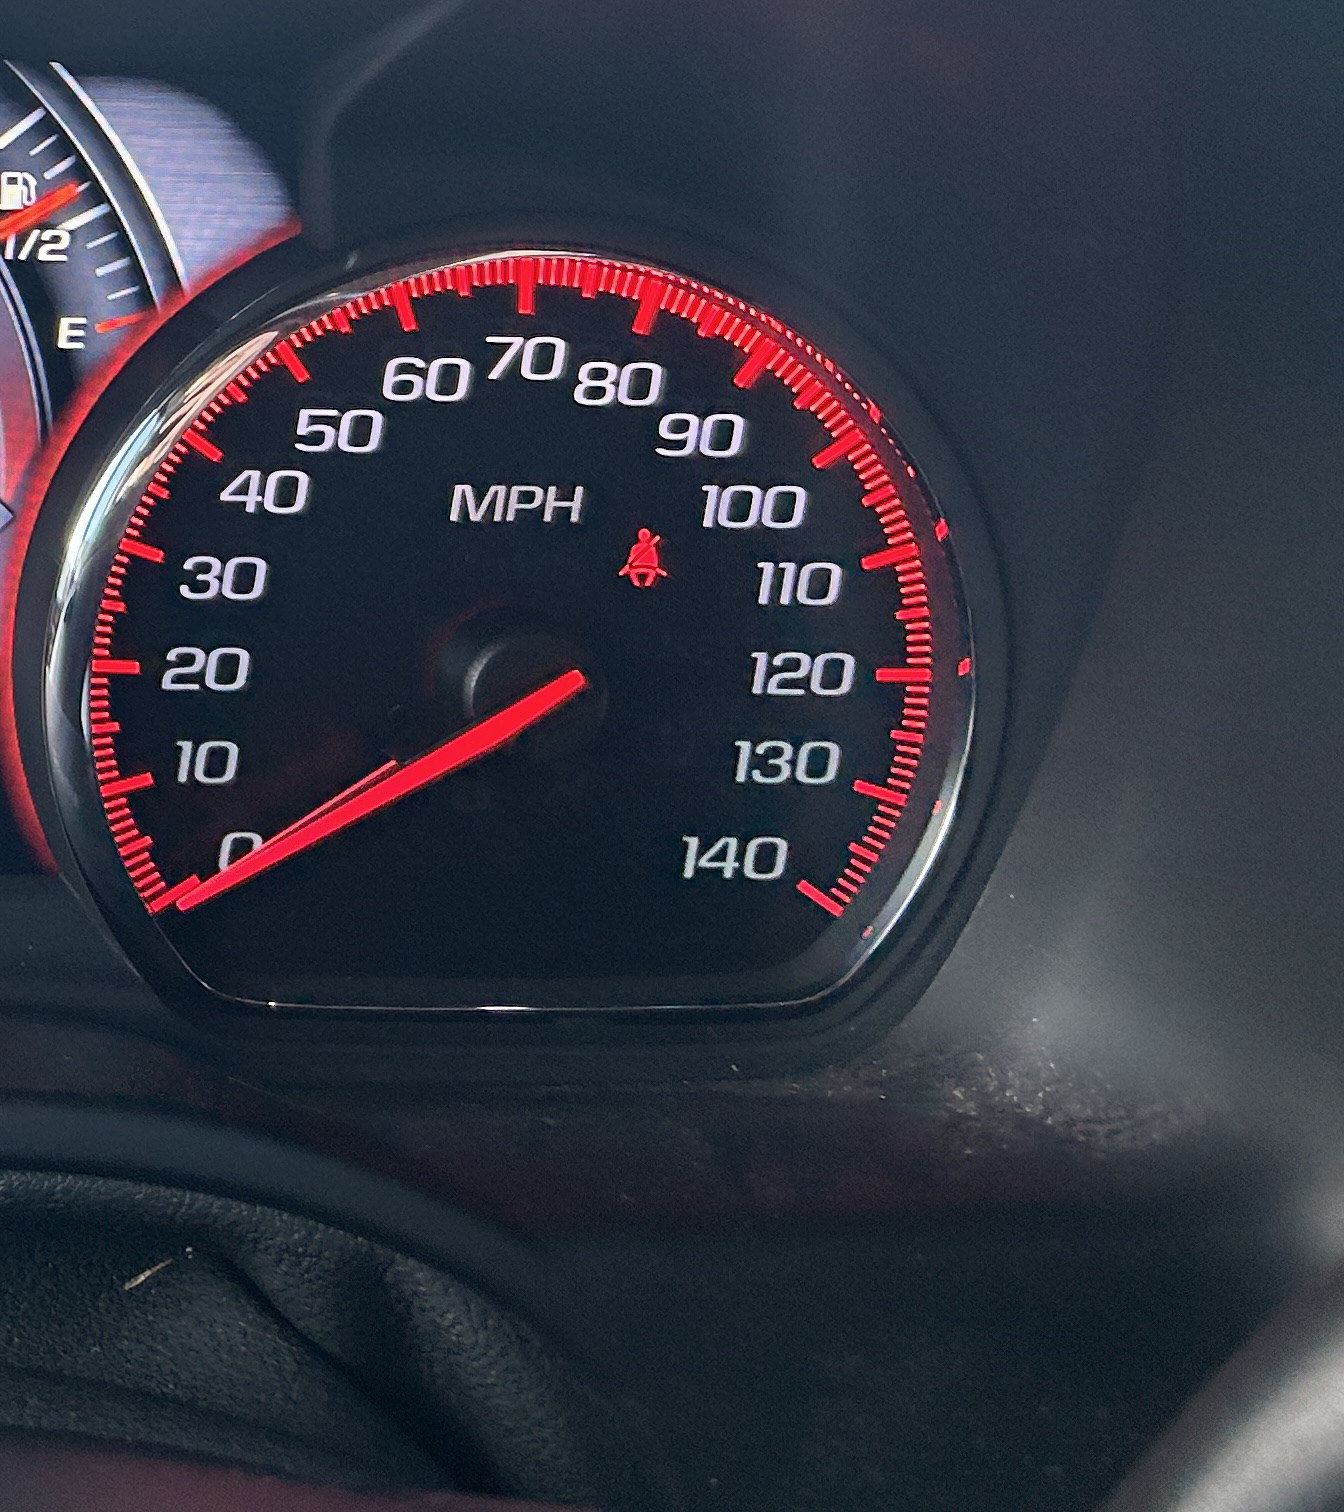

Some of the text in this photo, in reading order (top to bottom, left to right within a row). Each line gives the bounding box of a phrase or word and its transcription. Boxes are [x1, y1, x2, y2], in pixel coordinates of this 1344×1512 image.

[4, 228, 71, 262] 1/2
[57, 316, 89, 350] E
[382, 356, 472, 402] 60
[485, 336, 566, 381] 70
[573, 361, 664, 407] 80
[294, 408, 384, 453] 50
[654, 412, 746, 458] 90
[219, 469, 310, 515] 40
[449, 484, 584, 523] MPH
[701, 484, 808, 529] 100
[179, 555, 268, 601] 30
[756, 561, 843, 606] 110
[161, 646, 251, 692] 20
[750, 651, 856, 696] 120
[175, 740, 239, 784] 10
[734, 740, 841, 785] 130
[681, 836, 789, 880] 140
